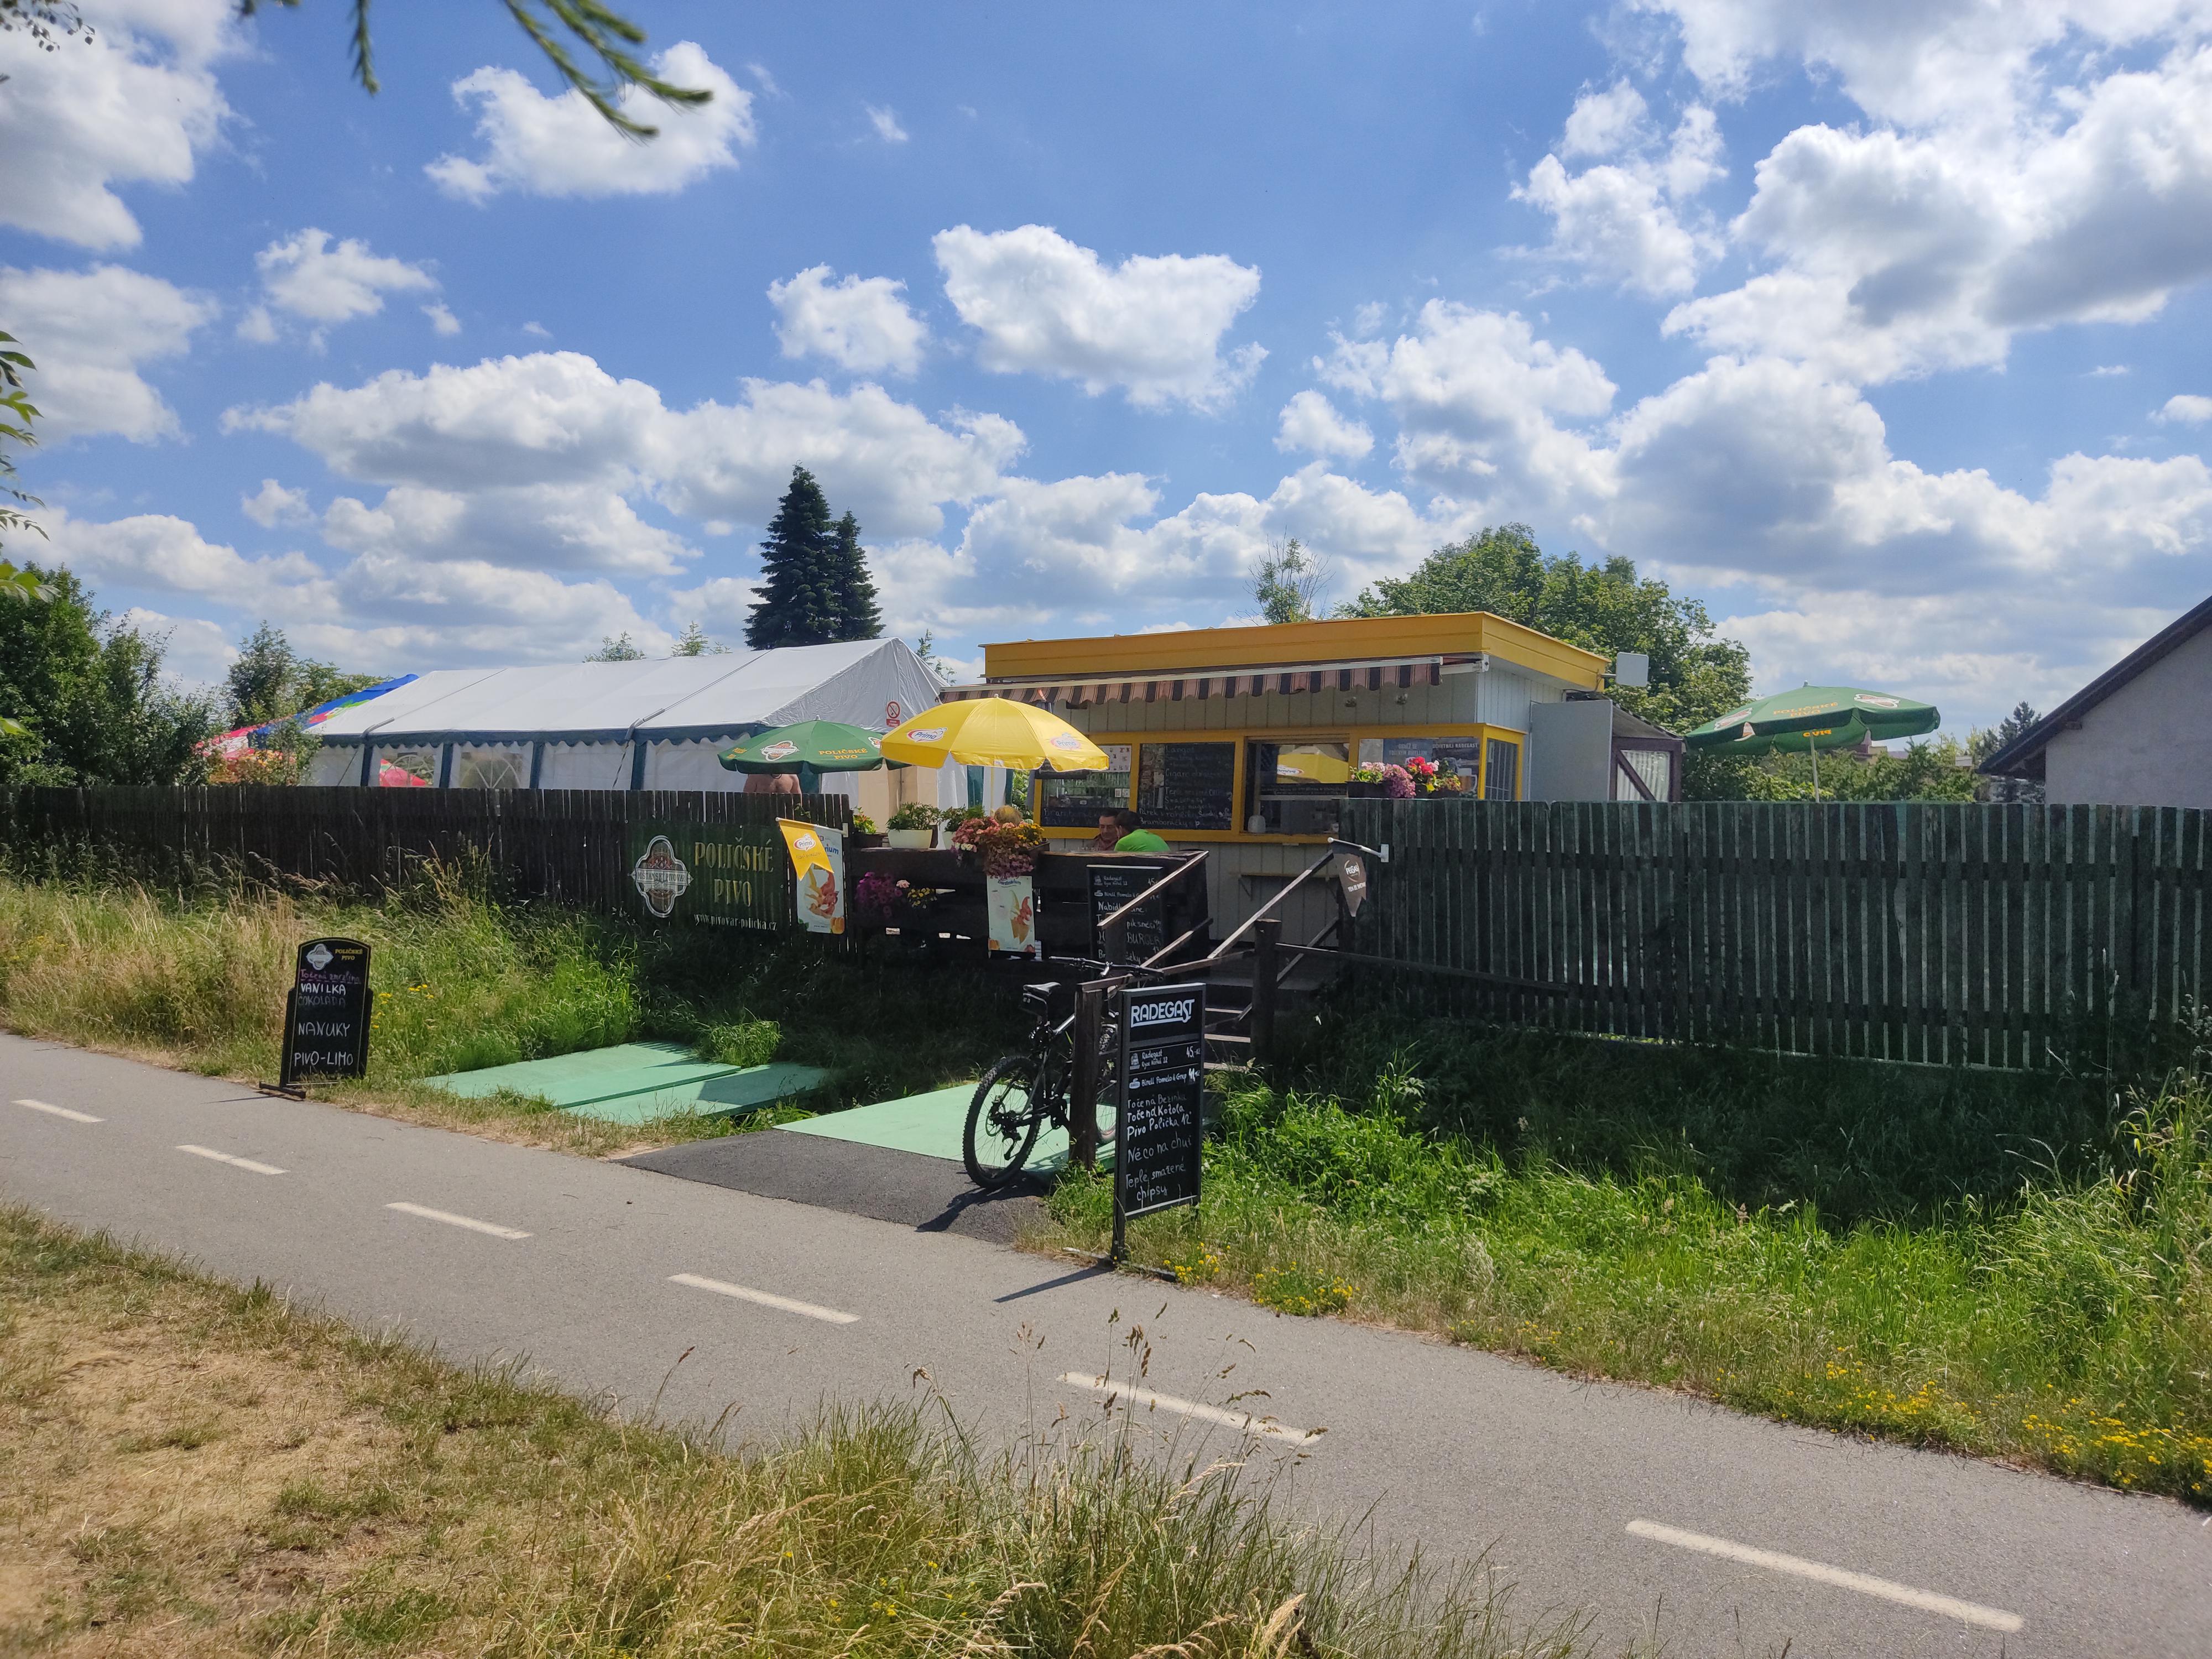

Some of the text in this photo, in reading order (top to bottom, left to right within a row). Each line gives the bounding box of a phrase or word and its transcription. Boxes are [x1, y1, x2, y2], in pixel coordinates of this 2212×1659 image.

[695, 837, 774, 873] POLIČSKÉ
[714, 879, 752, 907] PIVO
[300, 983, 346, 996] VANILKA
[1130, 998, 1195, 1028] RADEGAST
[299, 1021, 351, 1037] NANUKY
[294, 1051, 353, 1067] PIVO-LIMO
[1142, 1048, 1162, 1060] Radegast
[1142, 1077, 1155, 1087] Birell
[1156, 1075, 1172, 1084] Pomelo
[1128, 1094, 1156, 1109] Točená
[1128, 1106, 1157, 1123] Točená
[1127, 1125, 1146, 1141] Pivo
[1149, 1117, 1179, 1131] Polička
[1128, 1146, 1154, 1163] Něco
[1157, 1142, 1169, 1154] na
[1126, 1156, 1186, 1190] Teplé smažené
[1136, 1185, 1167, 1202] chipsy
